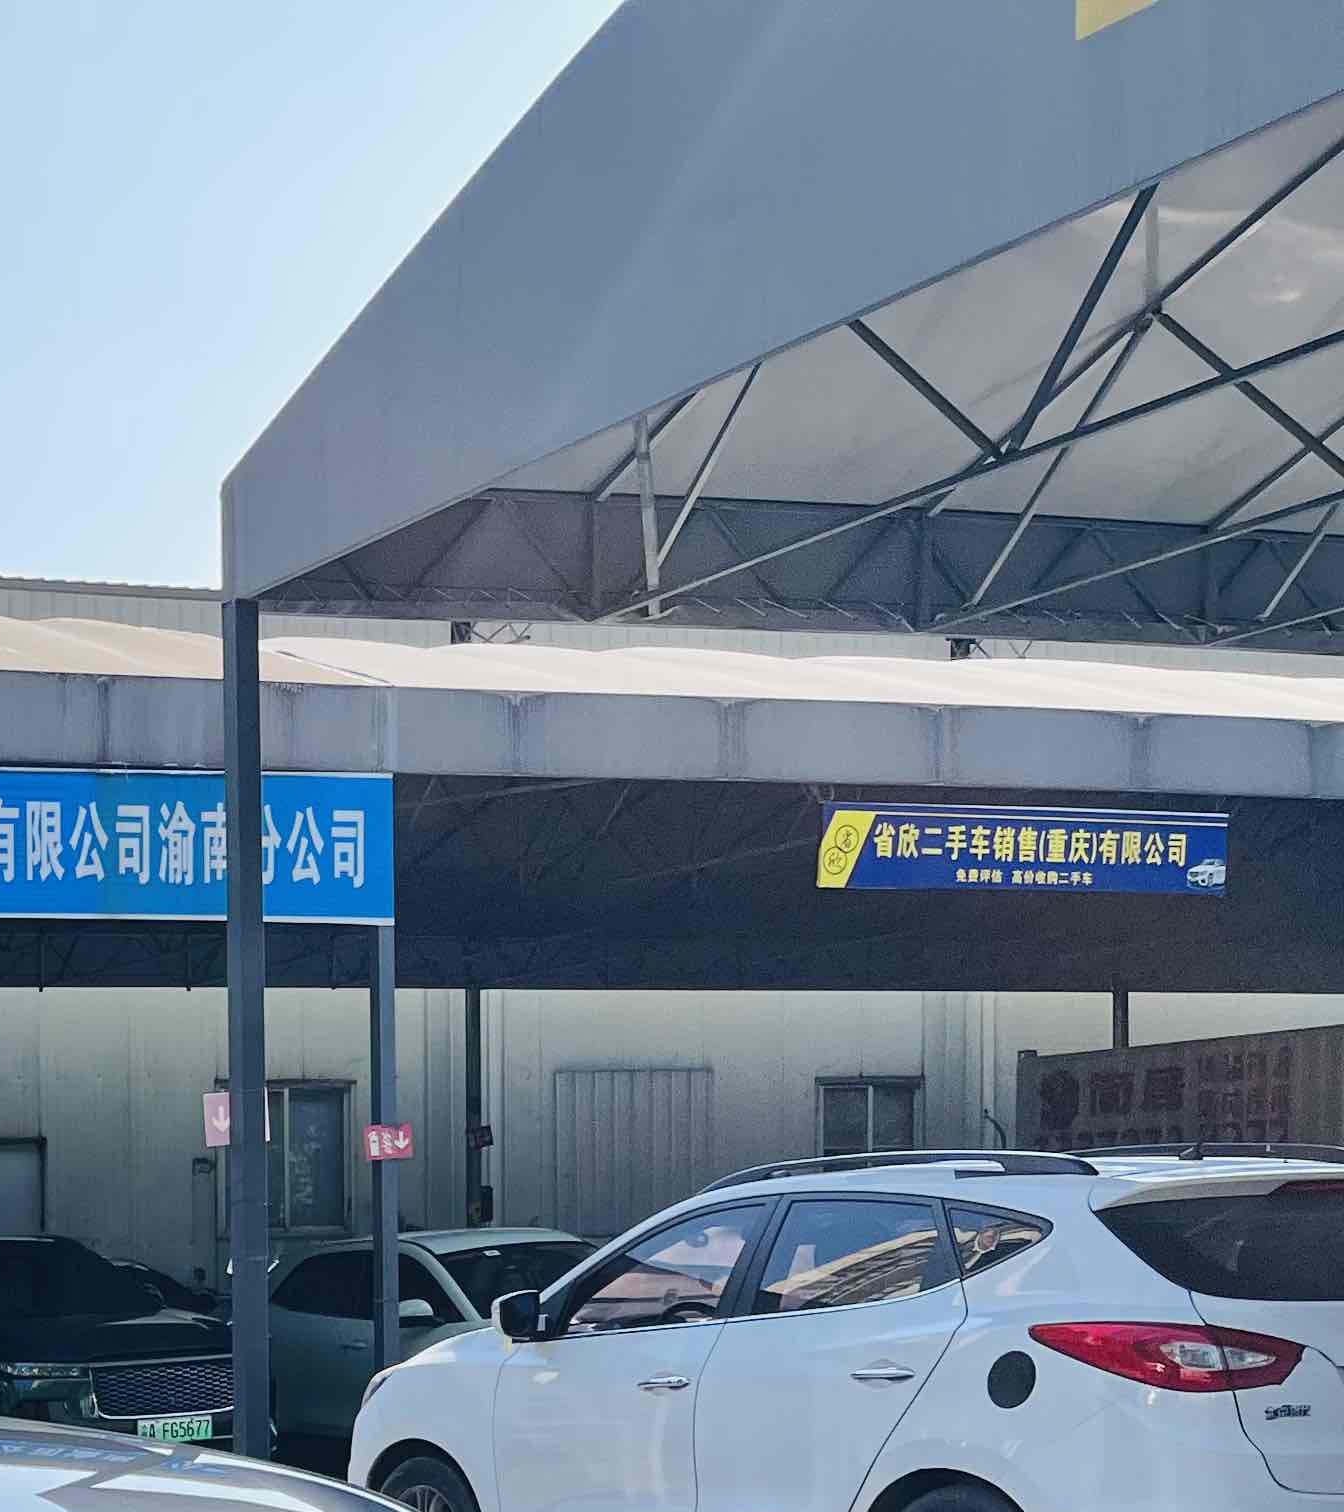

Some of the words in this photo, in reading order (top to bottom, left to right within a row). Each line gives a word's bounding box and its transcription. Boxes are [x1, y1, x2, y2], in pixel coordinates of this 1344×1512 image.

[873, 822, 1188, 867] 省欣二手车销售(重庆)有限公司
